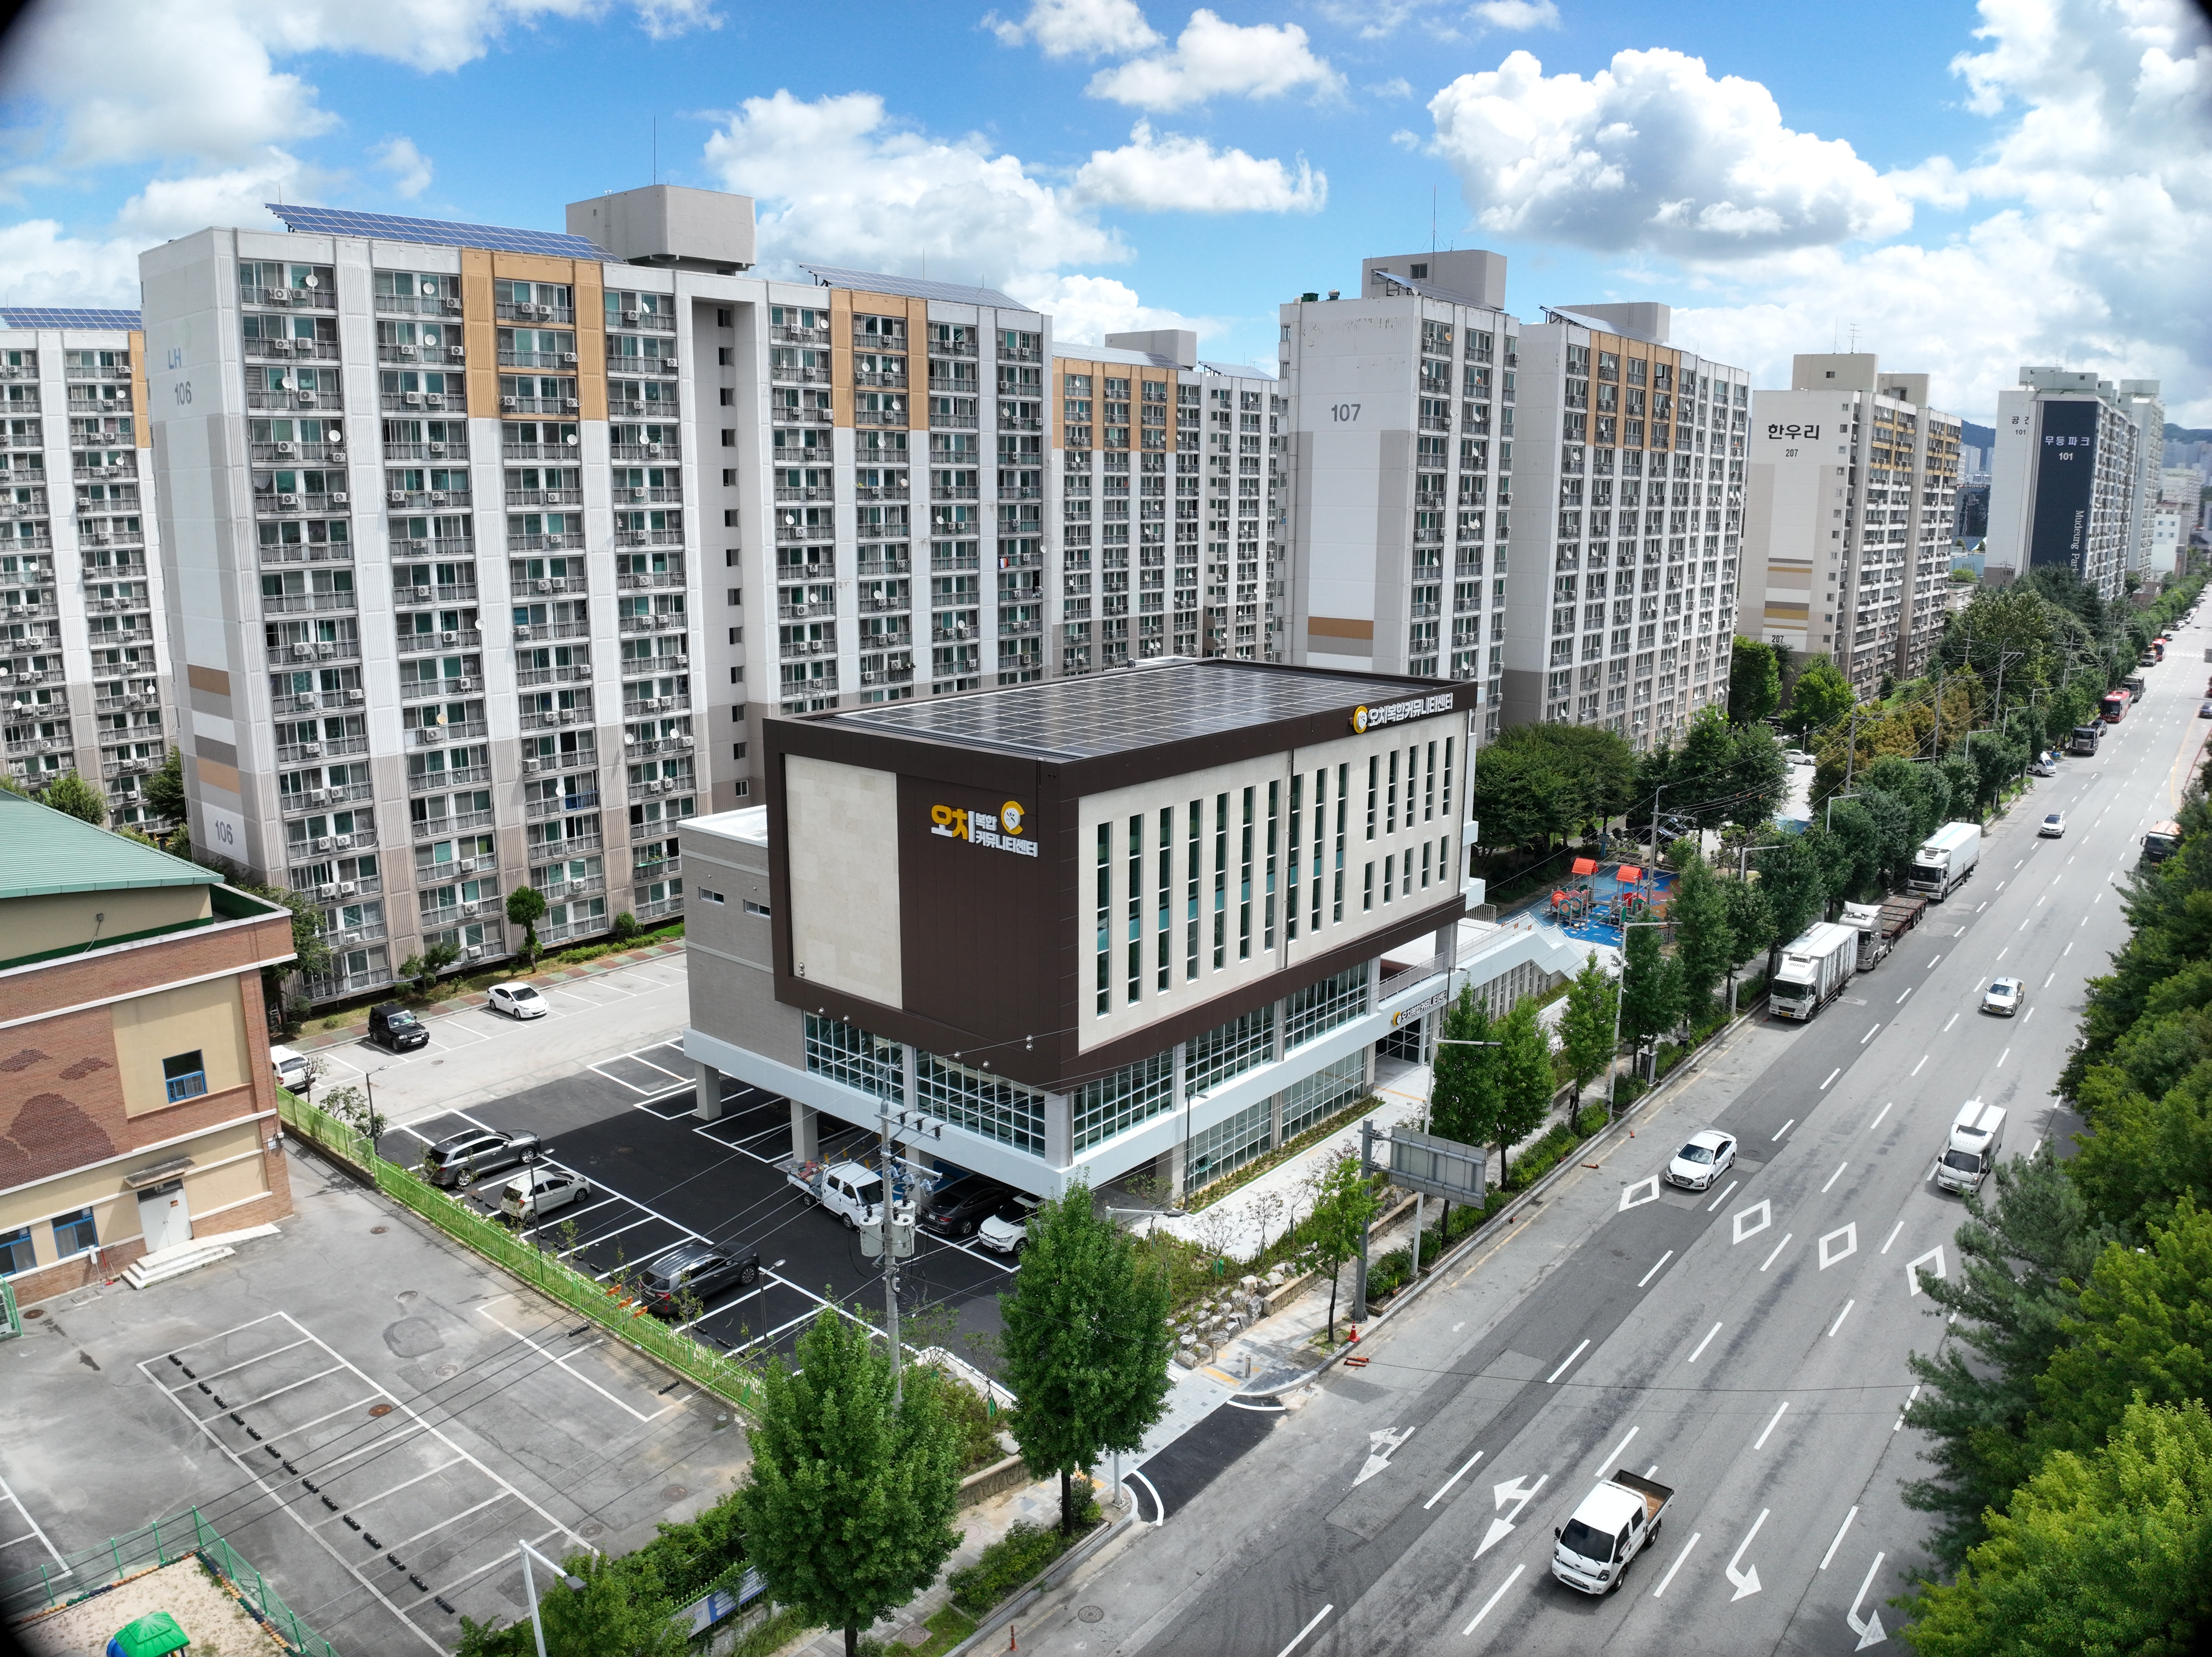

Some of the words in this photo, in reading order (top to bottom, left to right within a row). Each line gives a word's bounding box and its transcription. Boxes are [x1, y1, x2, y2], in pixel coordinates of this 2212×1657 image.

[168, 348, 182, 369] LH
[175, 381, 191, 405] 106
[1331, 404, 1361, 422] 107
[1768, 424, 1819, 440] 한우리
[2045, 436, 2090, 446] 무등파크
[2059, 452, 2073, 461] 101
[2070, 510, 2085, 550] Mudeung
[1772, 635, 1784, 643] 207
[931, 805, 975, 843] 오치
[975, 813, 997, 831] 복합
[215, 820, 233, 845] 106
[976, 830, 1038, 857] 커뮤니티센터
